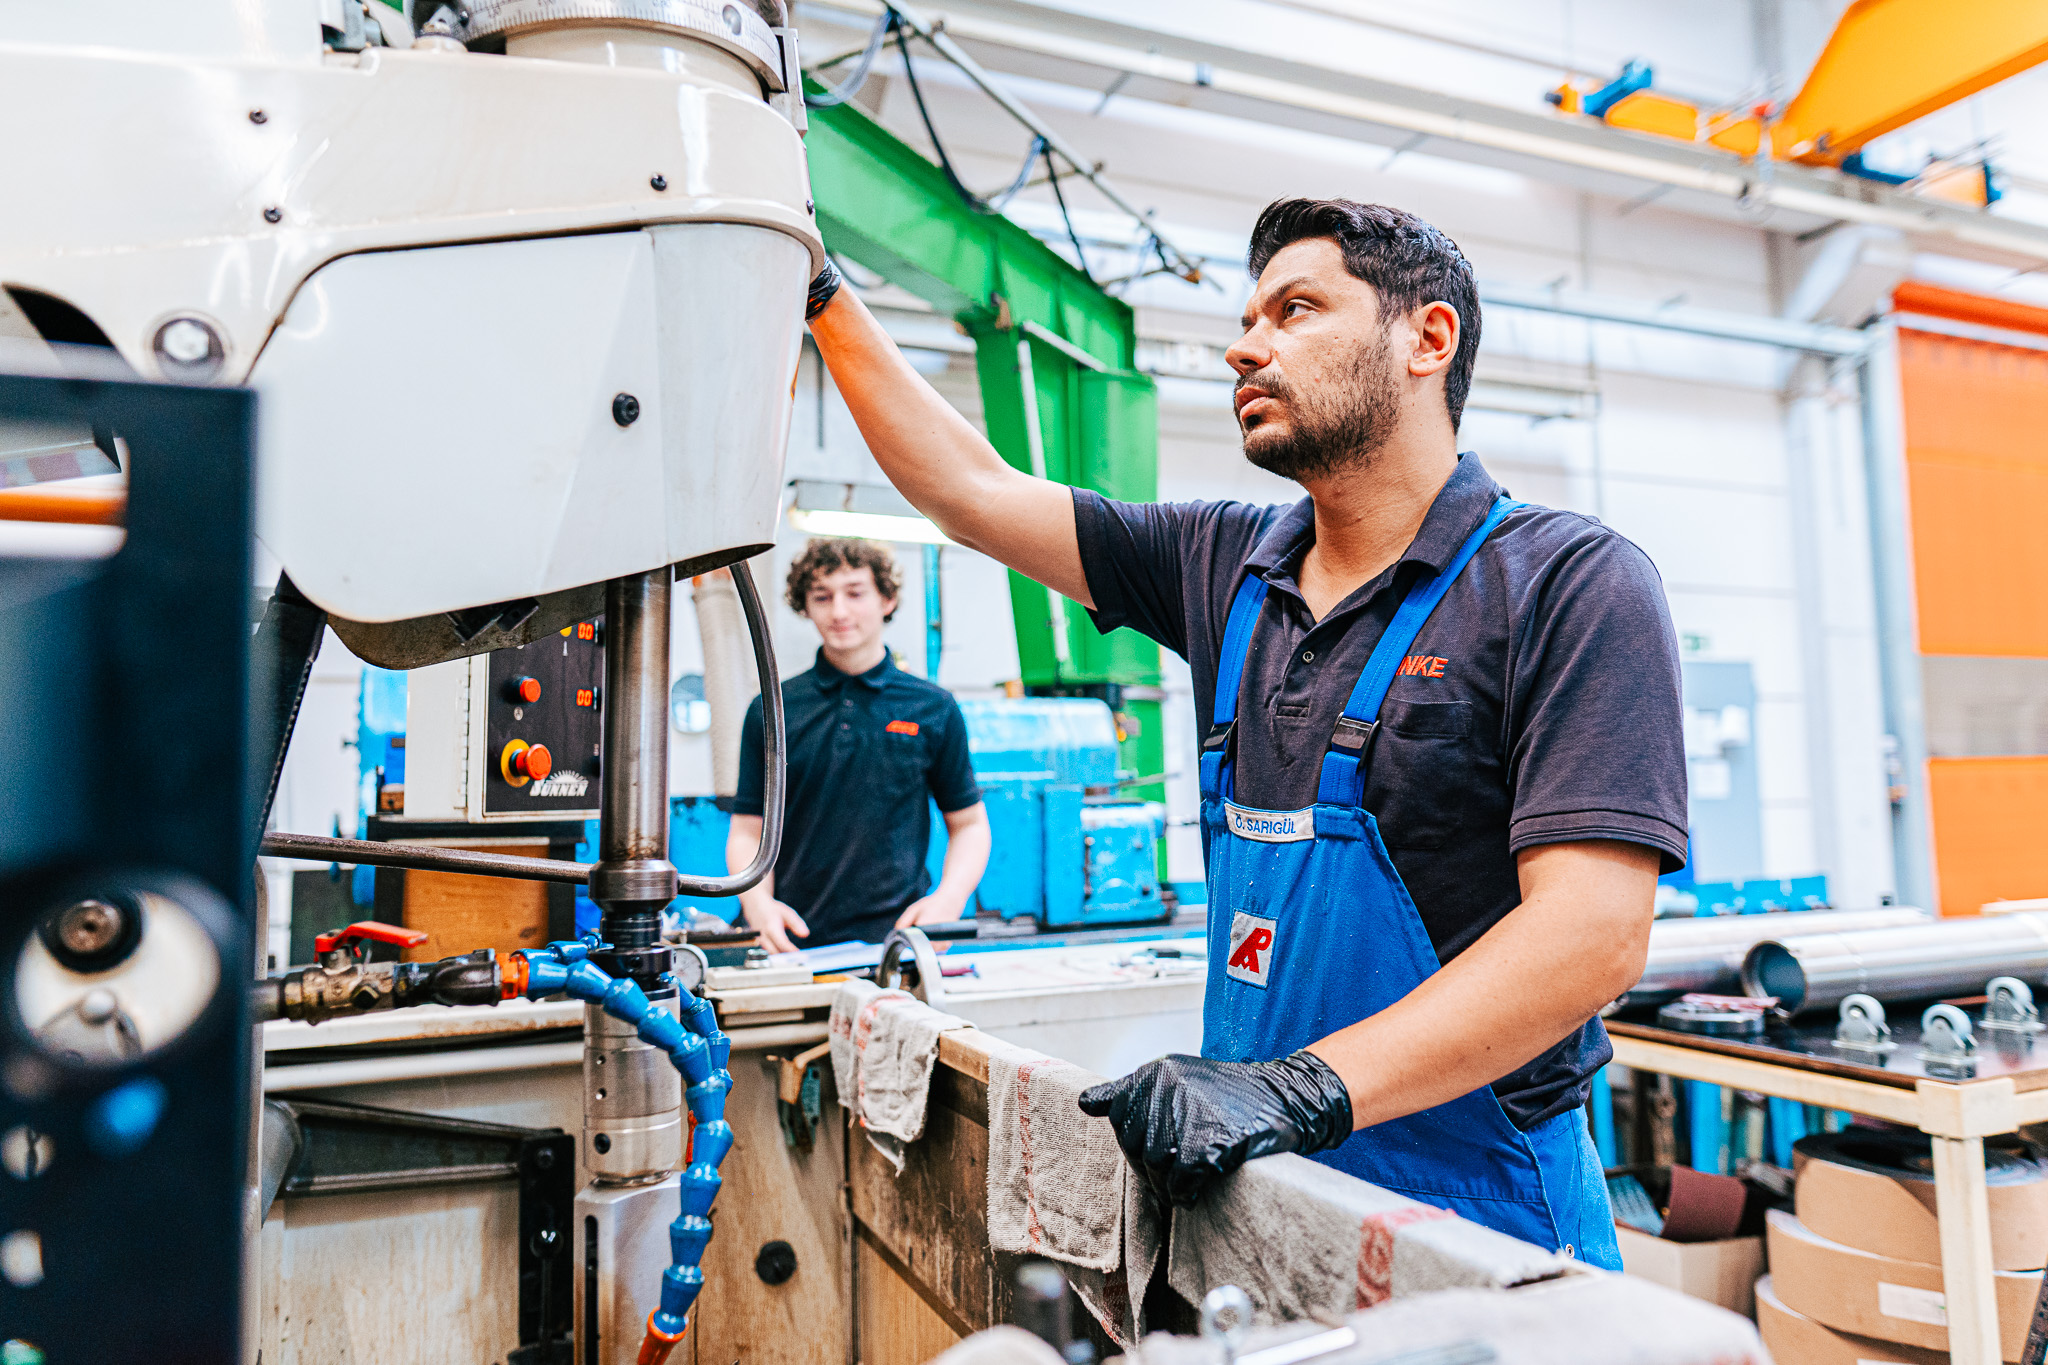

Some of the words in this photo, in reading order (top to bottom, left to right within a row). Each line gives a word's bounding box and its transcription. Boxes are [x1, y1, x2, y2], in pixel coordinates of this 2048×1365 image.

[577, 622, 594, 640] 00
[1396, 655, 1449, 679] NKE
[576, 689, 593, 707] 00
[1235, 812, 1246, 830] Ö.
